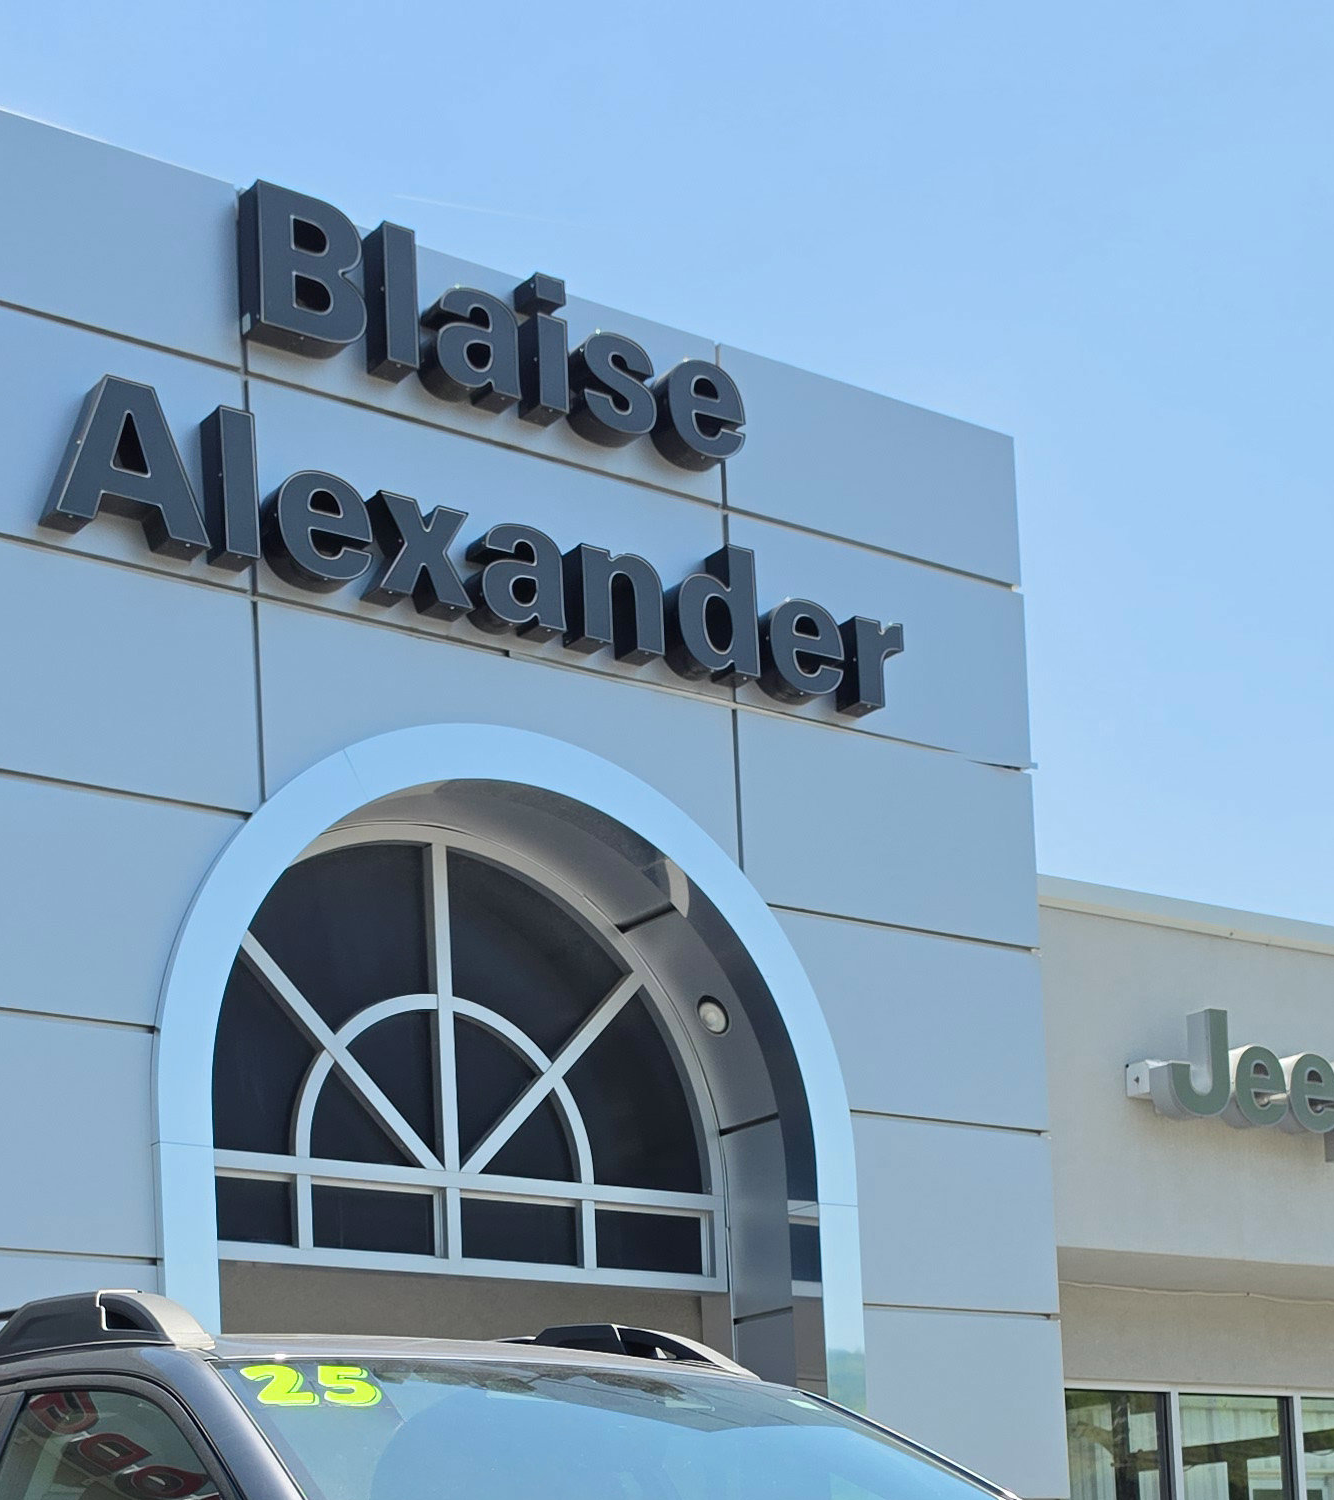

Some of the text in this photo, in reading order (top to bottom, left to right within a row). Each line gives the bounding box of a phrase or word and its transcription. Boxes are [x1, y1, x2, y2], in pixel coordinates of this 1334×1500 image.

[238, 179, 746, 472] Blaise
[38, 374, 903, 717] Alexander
[240, 1364, 383, 1407] 25
